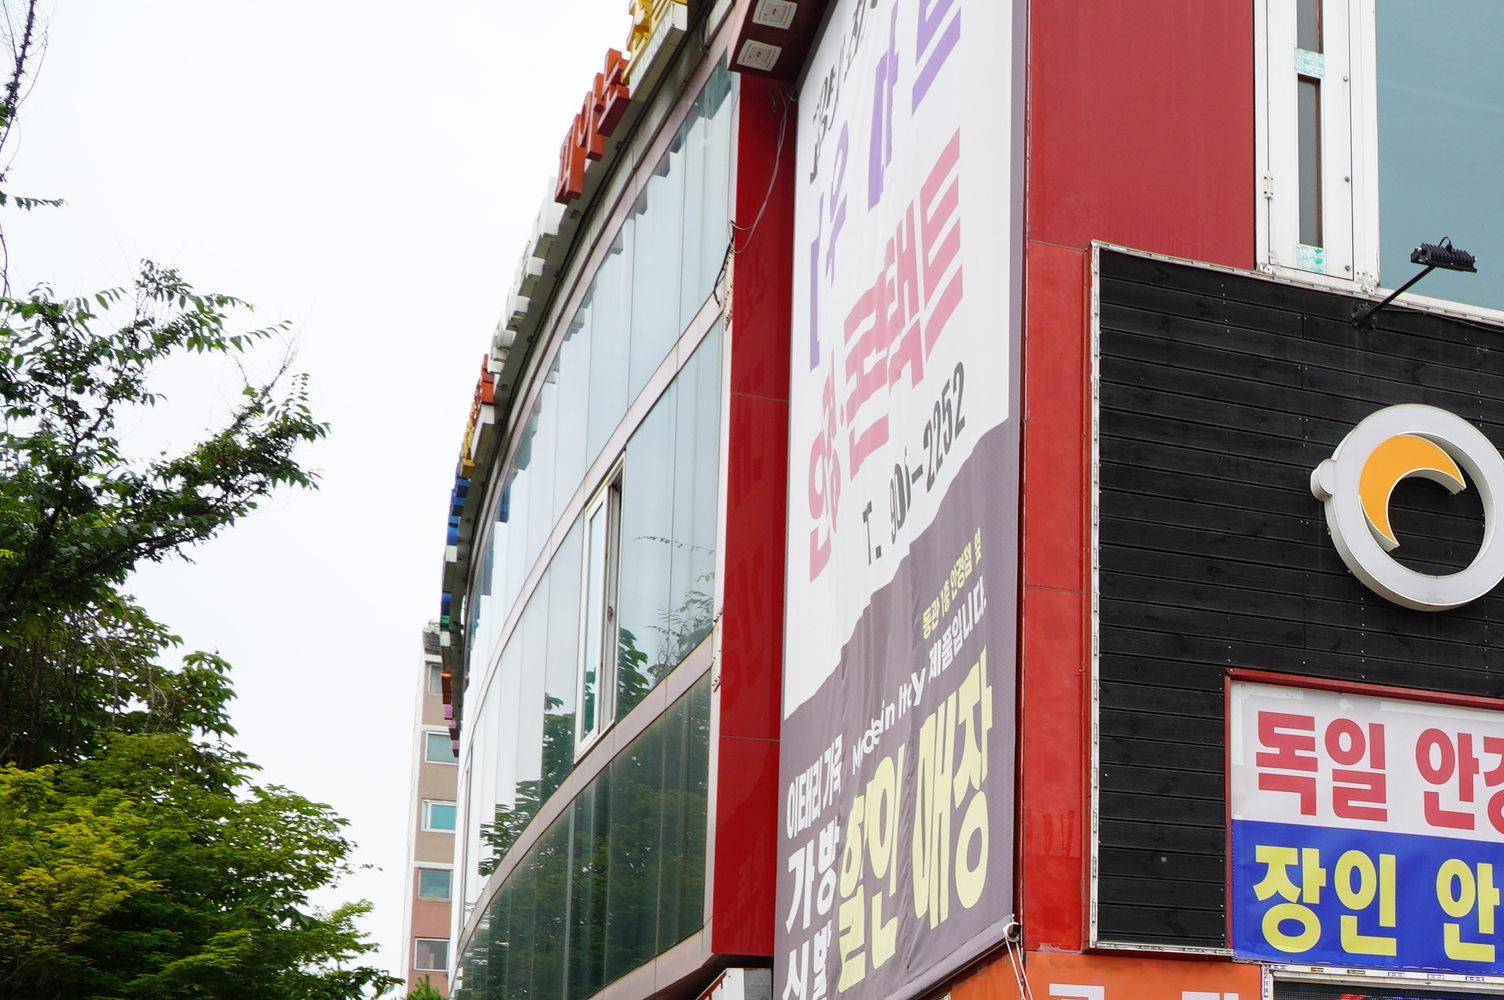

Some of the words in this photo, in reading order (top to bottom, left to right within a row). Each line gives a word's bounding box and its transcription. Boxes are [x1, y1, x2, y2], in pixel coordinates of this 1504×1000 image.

[1255, 710, 1388, 823] 독일
[786, 815, 840, 934] 가방
[1252, 844, 1397, 957] 장인
